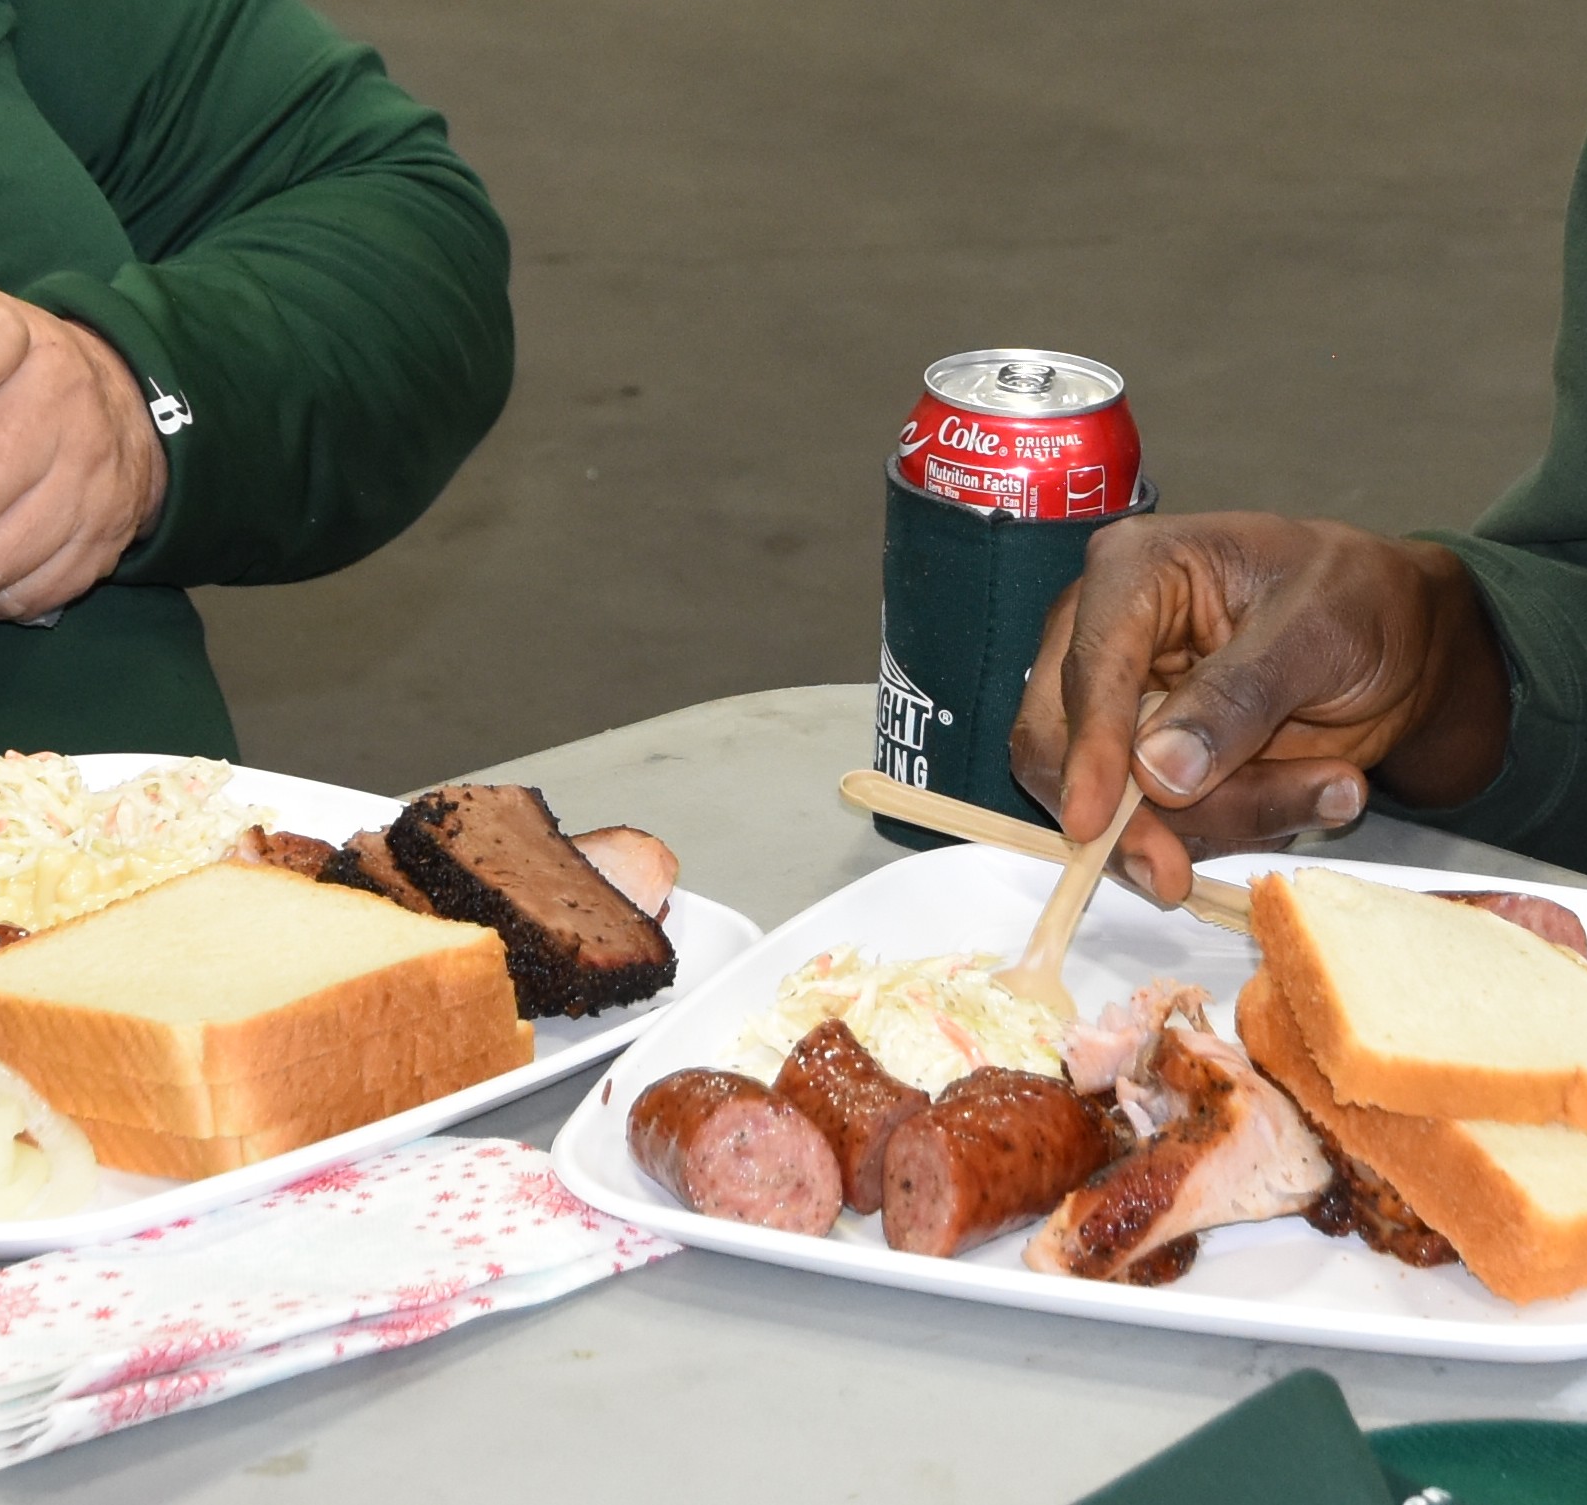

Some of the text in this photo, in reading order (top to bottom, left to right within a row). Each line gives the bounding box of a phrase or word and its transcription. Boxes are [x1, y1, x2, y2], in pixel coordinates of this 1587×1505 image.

[937, 415, 1000, 456] Coke
[1015, 433, 1083, 447] ORIGINAL
[1014, 447, 1061, 459] TASTE
[928, 460, 1022, 493] Nutrition Facts
